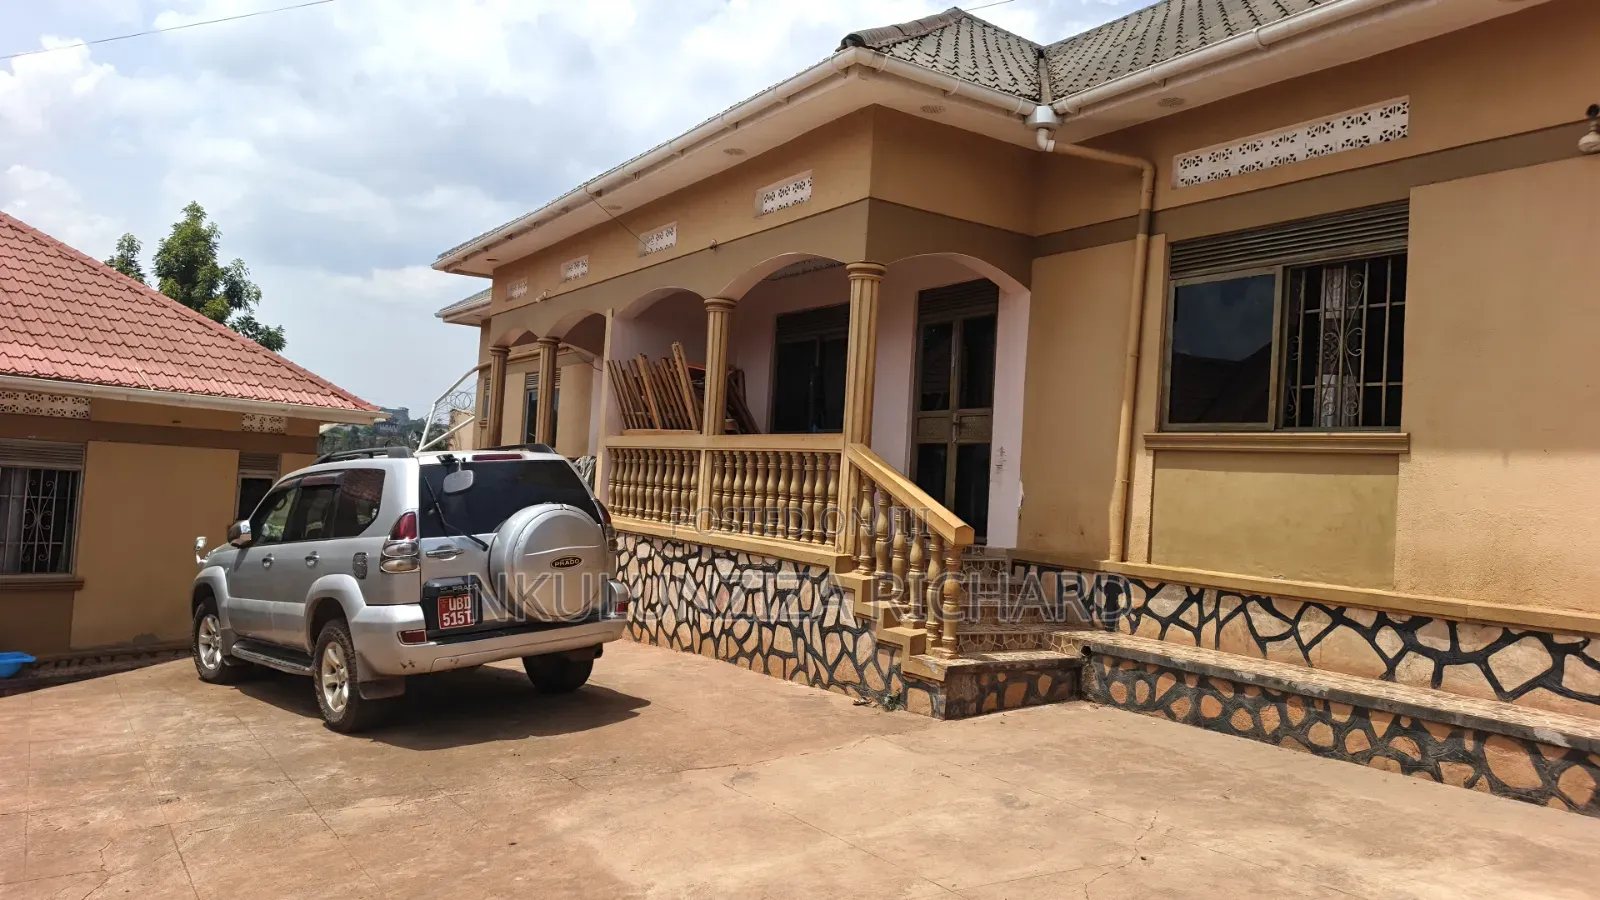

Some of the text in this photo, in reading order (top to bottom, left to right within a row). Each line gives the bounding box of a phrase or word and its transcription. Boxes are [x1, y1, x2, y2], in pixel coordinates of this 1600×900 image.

[554, 558, 580, 567] PRADO
[448, 596, 472, 611] UBD
[442, 610, 472, 627] 515T
